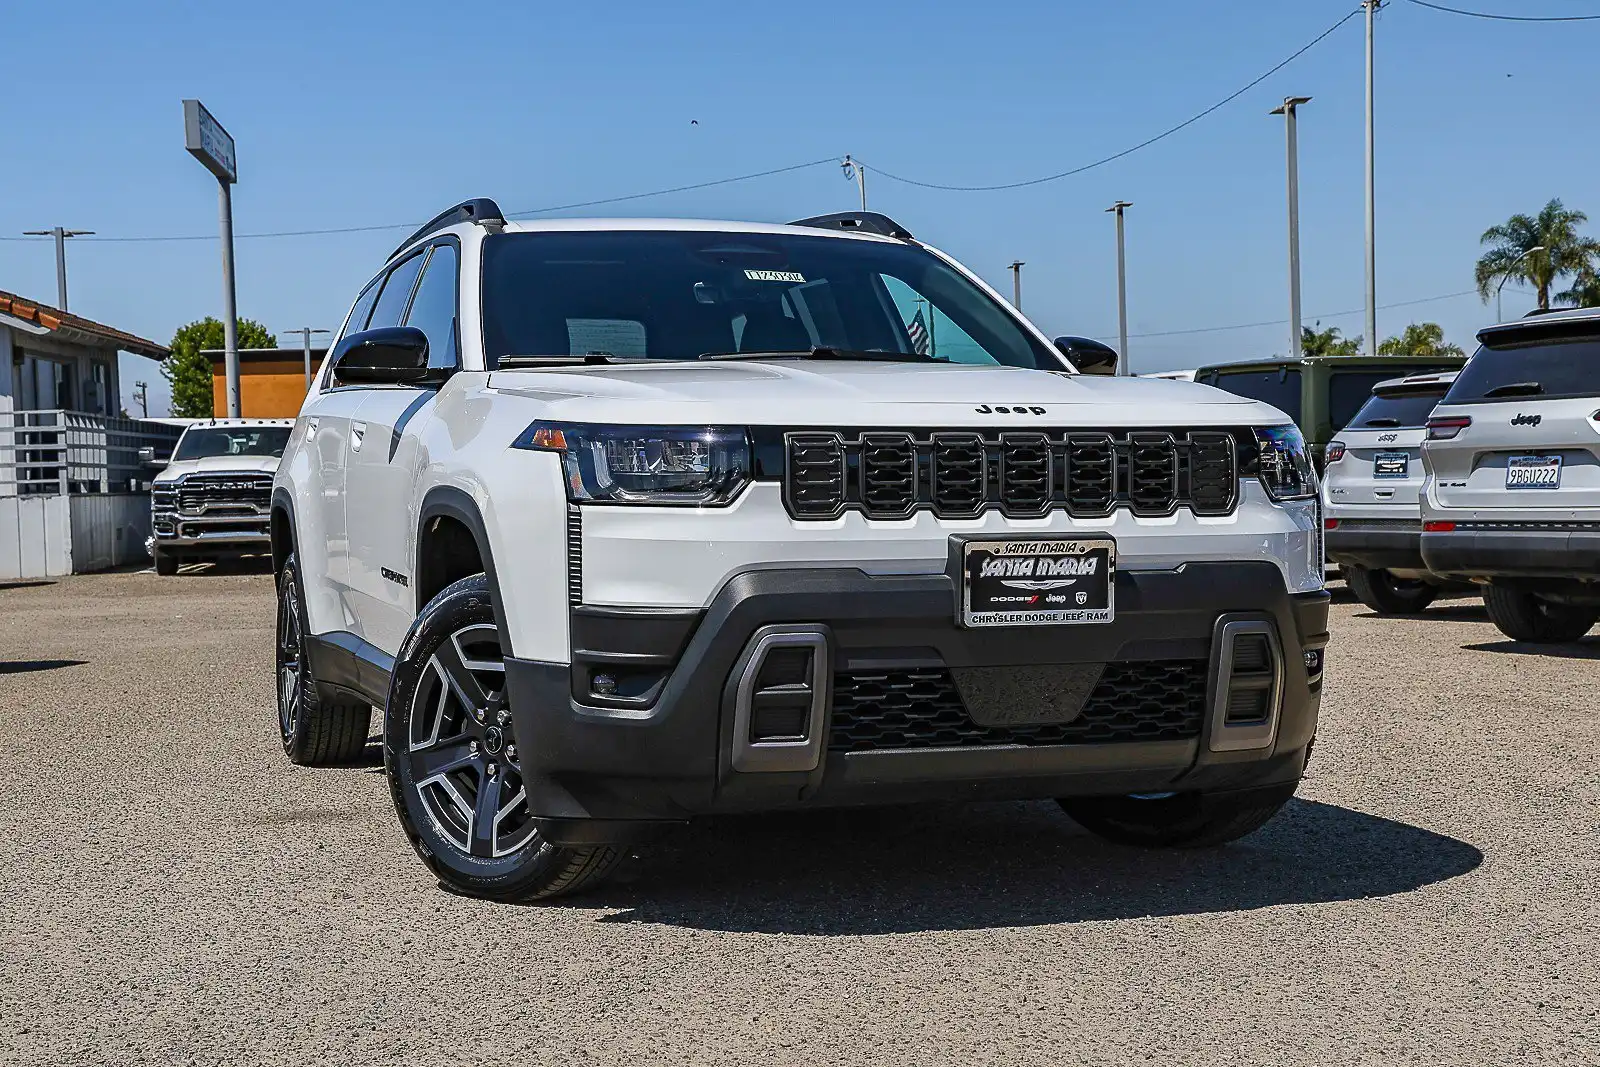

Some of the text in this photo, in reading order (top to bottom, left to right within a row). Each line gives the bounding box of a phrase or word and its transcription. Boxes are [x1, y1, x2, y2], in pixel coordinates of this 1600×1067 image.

[975, 404, 1047, 416] Jeep
[1510, 413, 1542, 427] Jeep
[1510, 468, 1556, 484] 9BGU222
[1004, 542, 1078, 554] SANTA MARIA
[980, 556, 1099, 579] SANTA MARIA
[990, 595, 1034, 603] DODGE
[1045, 593, 1067, 604] Jeep
[971, 612, 1109, 624] CHRYSLER DODGE JEEP RAM
